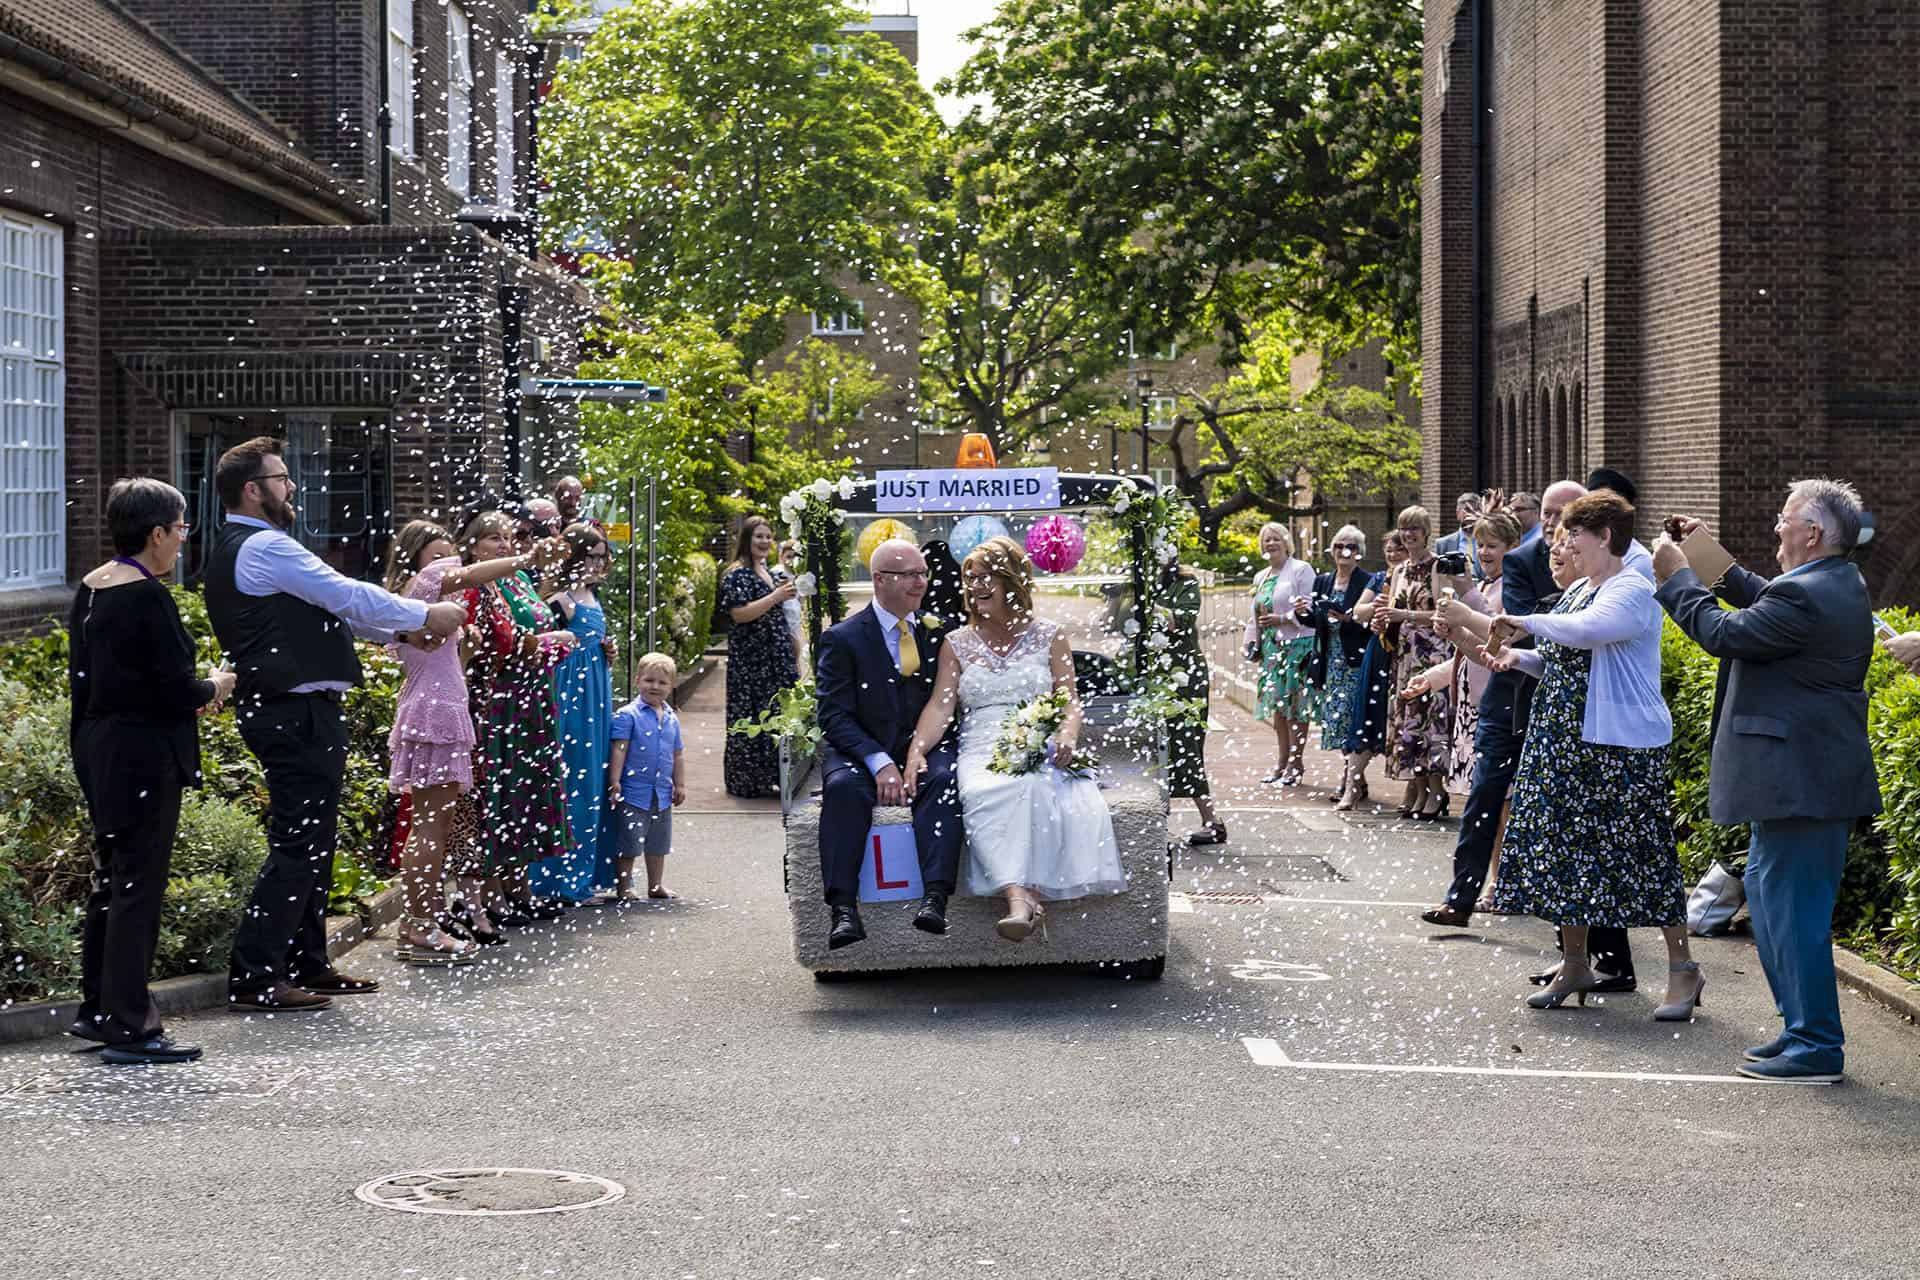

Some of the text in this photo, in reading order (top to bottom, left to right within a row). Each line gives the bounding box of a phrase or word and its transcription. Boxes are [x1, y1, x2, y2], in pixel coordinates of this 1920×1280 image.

[880, 478, 1041, 498] JUST MARRIED
[872, 834, 909, 890] L
